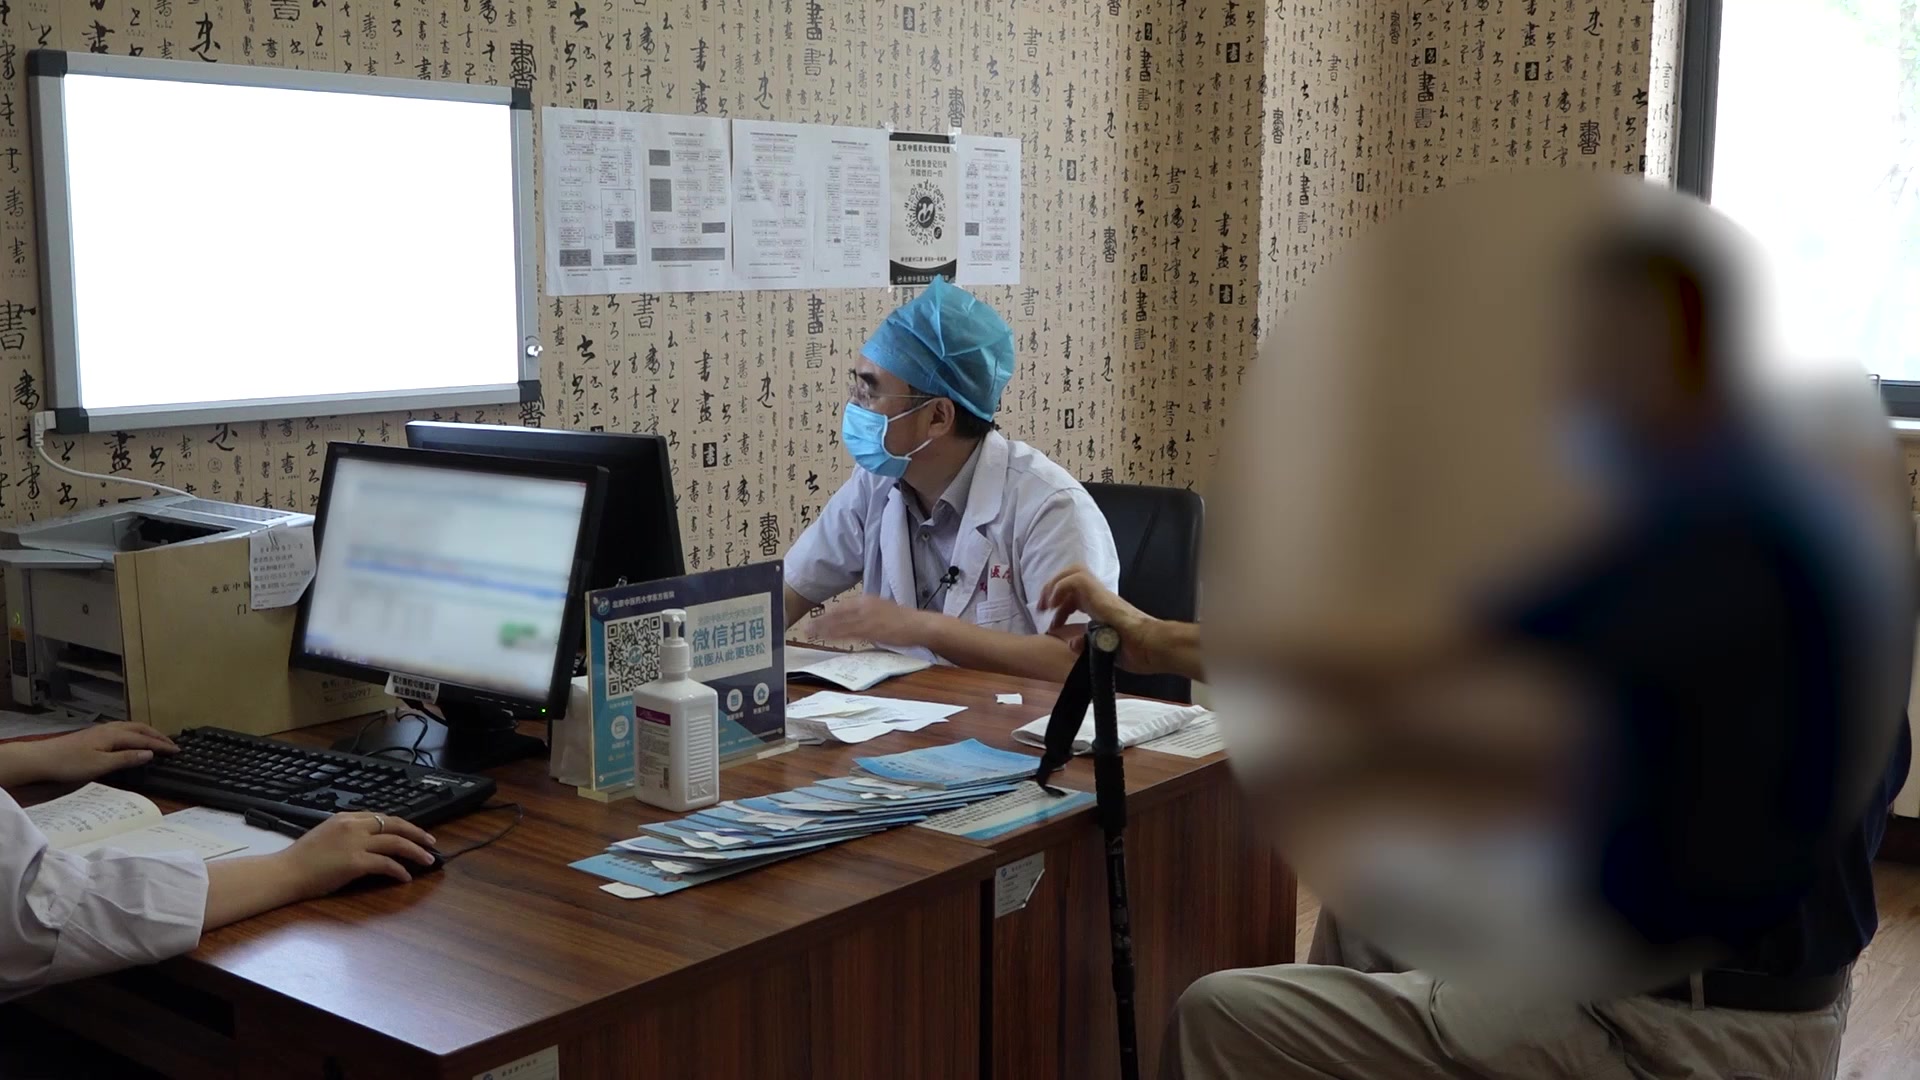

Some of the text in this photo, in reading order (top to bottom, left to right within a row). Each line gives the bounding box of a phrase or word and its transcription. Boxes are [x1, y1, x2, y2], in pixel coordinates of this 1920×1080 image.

[692, 618, 765, 652] 微信扫码
[692, 643, 766, 669] 就医从此更轻松
